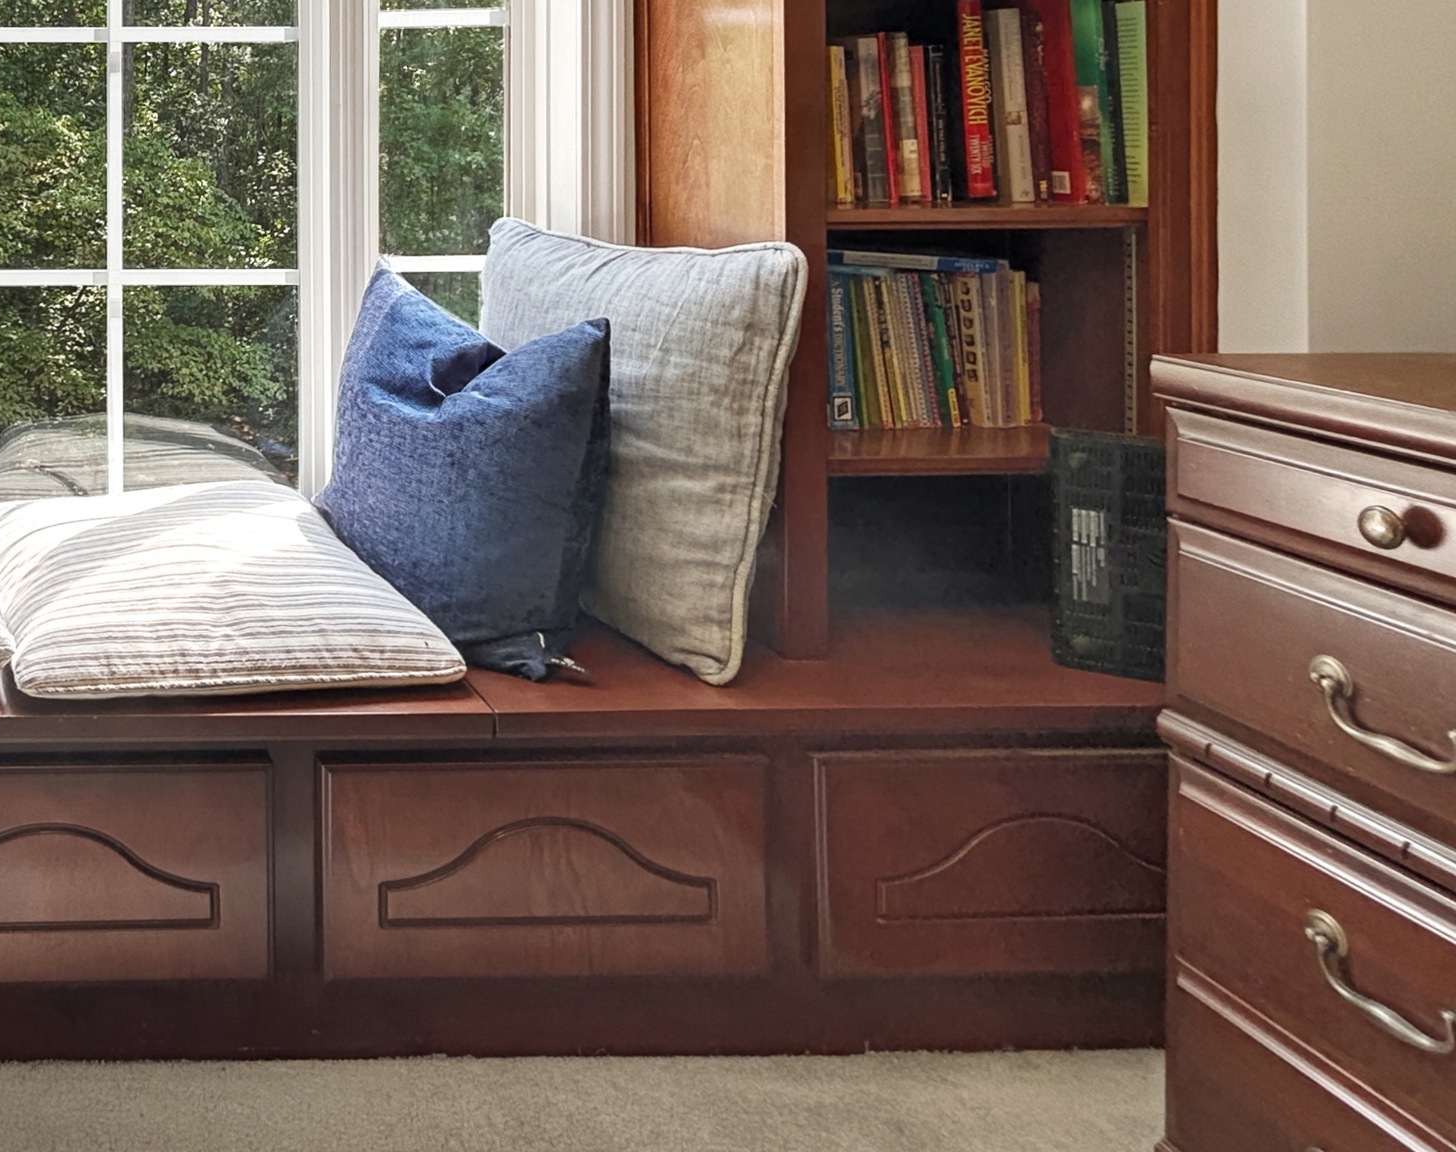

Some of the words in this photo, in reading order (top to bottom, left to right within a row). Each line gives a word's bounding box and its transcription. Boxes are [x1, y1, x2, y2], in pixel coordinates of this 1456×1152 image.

[961, 13, 983, 51] JANET
[964, 55, 987, 125] EVANOVICH
[832, 288, 845, 332] Student's
[835, 334, 846, 387] DICTIONARY
